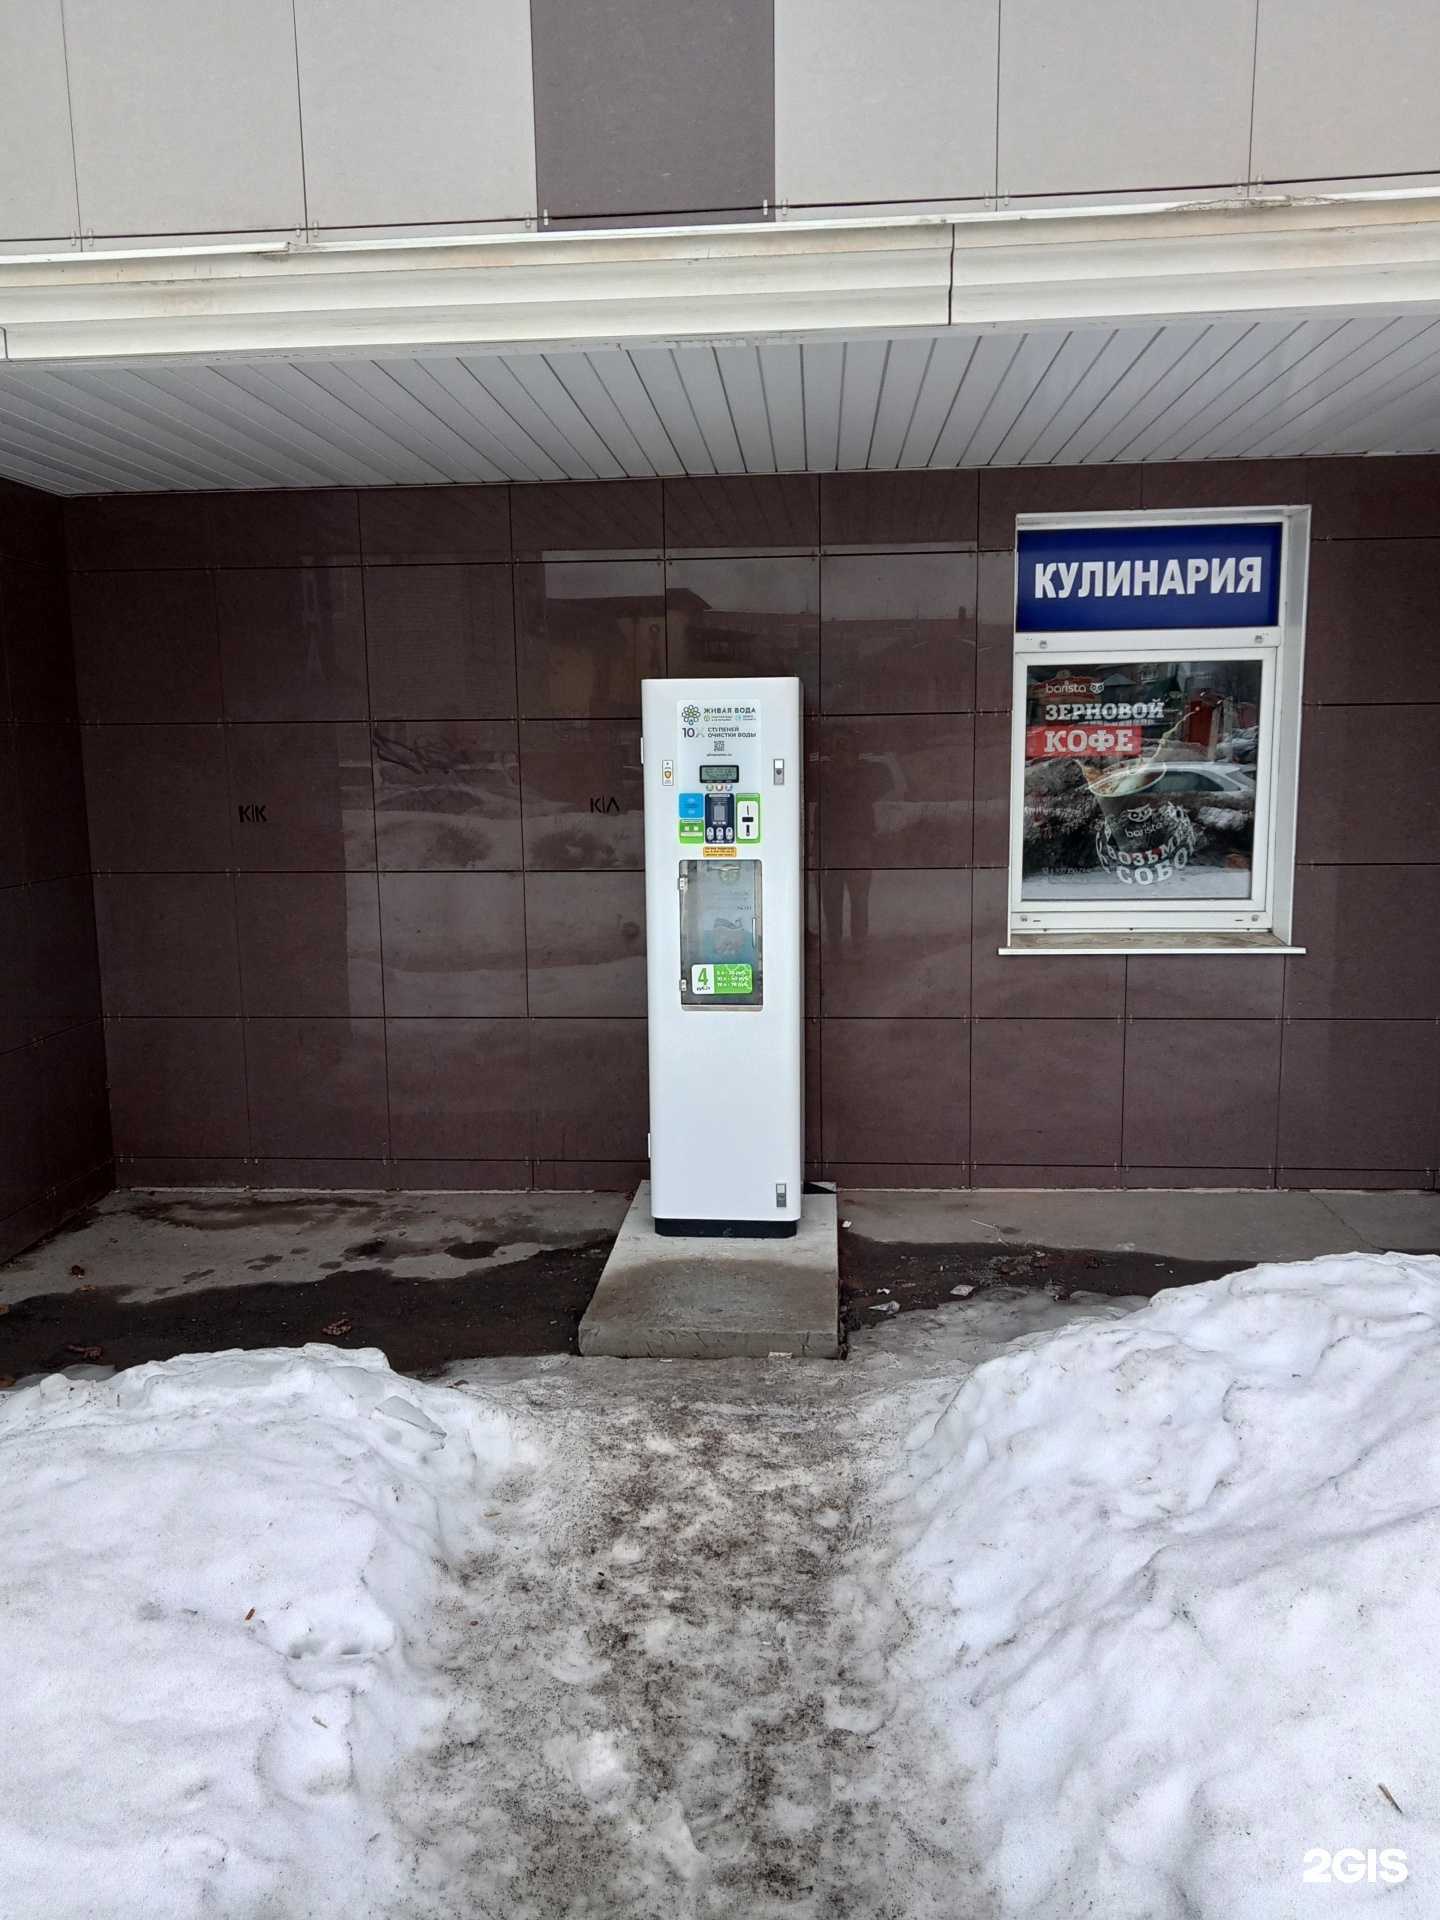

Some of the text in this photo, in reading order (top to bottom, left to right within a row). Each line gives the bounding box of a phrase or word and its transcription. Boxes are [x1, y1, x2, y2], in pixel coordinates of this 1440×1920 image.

[1034, 556, 1262, 599] КУЛИНАРИЯ
[1045, 681, 1087, 694] barista
[1045, 698, 1165, 721] ЗЕРНОВОЙ
[682, 727, 695, 738] 10
[1044, 729, 1134, 752] КОФЕ
[698, 967, 709, 986] 4
